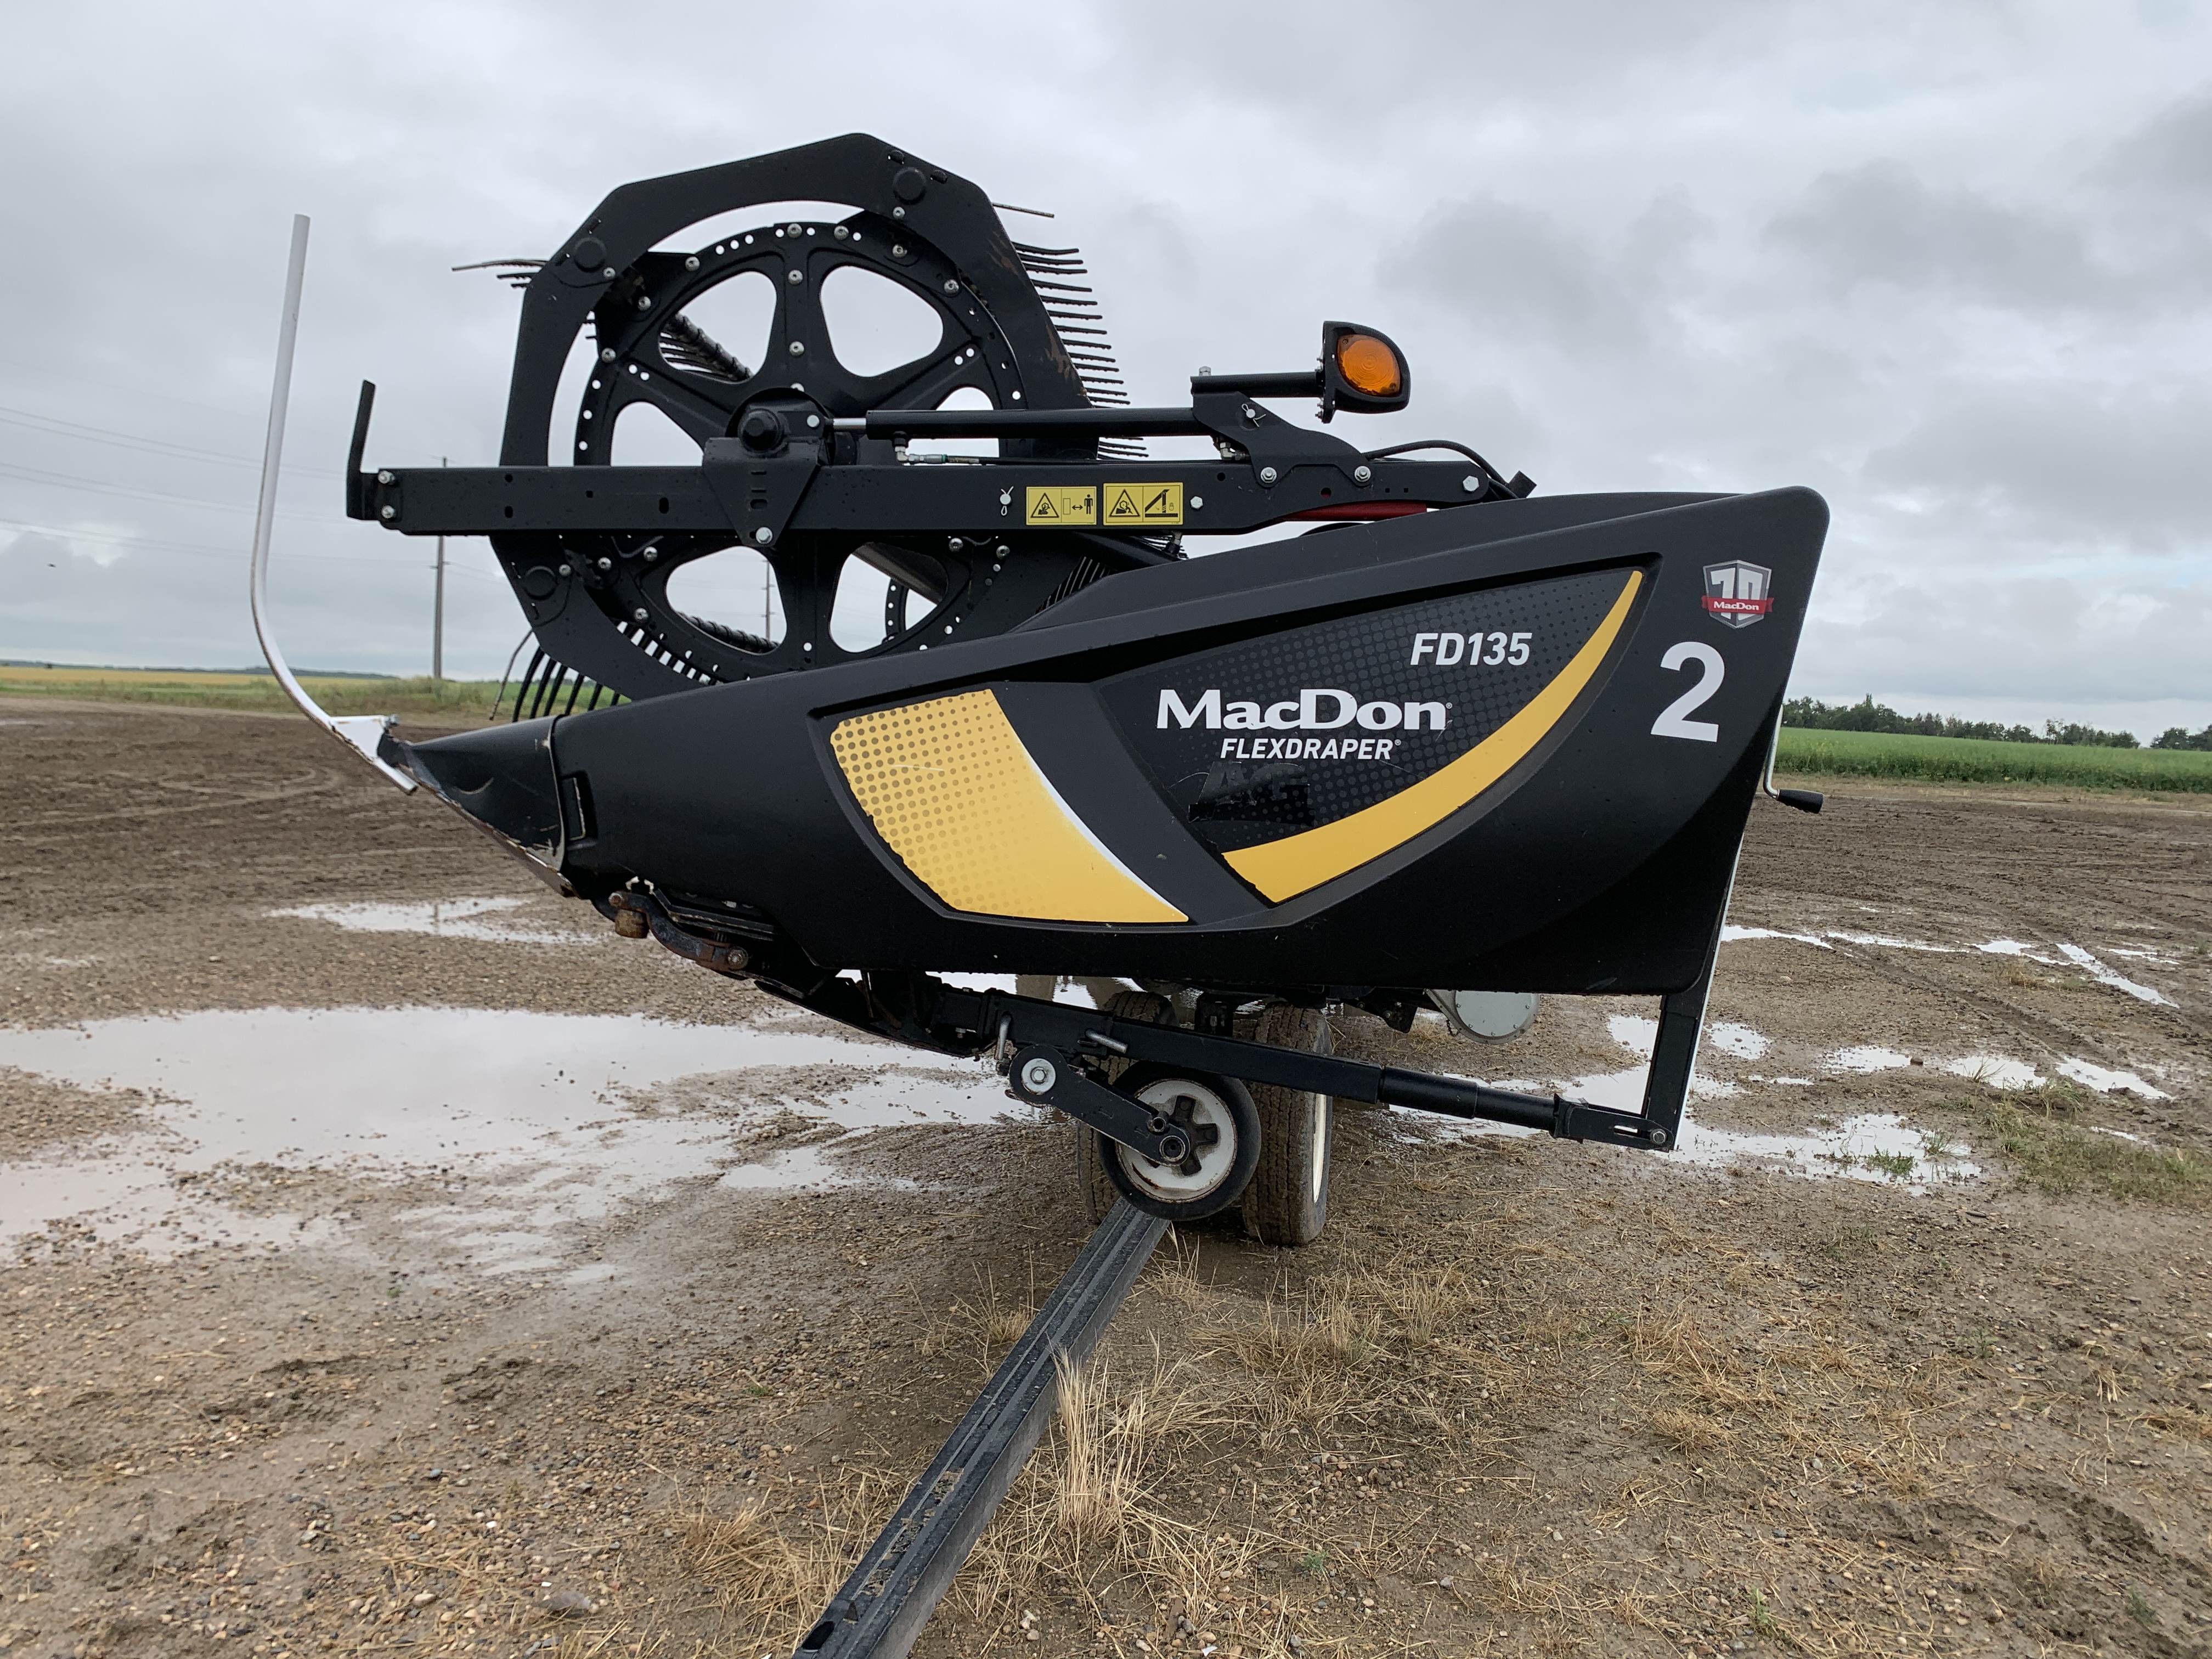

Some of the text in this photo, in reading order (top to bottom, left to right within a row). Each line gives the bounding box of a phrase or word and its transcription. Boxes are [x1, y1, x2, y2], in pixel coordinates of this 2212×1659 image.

[1713, 601, 1759, 611] MacDon
[1410, 632, 1533, 666] FD135
[1650, 641, 1725, 742] 2
[1156, 689, 1447, 731] MacDon
[1220, 738, 1394, 760] FLEXDRAPER
